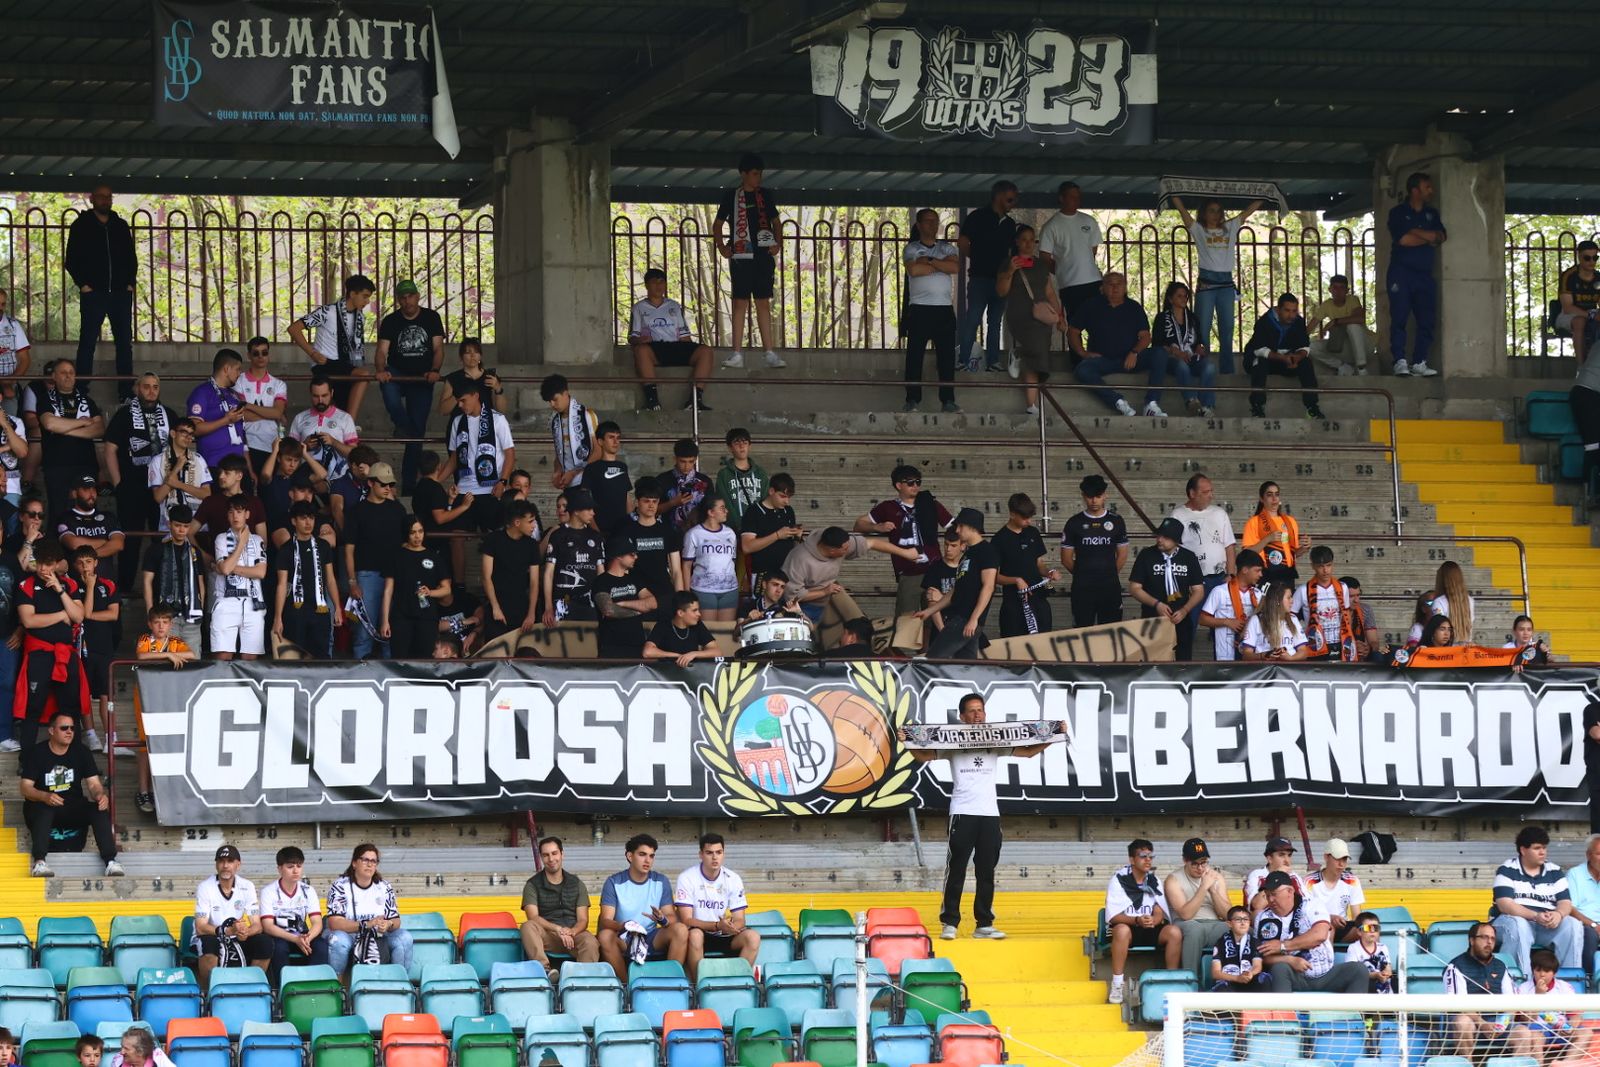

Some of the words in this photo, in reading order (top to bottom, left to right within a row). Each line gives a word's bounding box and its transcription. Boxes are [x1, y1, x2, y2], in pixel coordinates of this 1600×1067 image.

[1026, 28, 1129, 126] 23
[290, 64, 387, 106] FANS
[217, 110, 239, 120] QUOD
[242, 111, 276, 121] NATURA
[278, 111, 295, 121] NON
[925, 98, 1020, 131] ULTRAS
[76, 526, 107, 537] meins
[1082, 535, 1111, 546] meins
[1152, 562, 1188, 572] addas
[190, 684, 693, 791] GLORIOSA
[1132, 687, 1588, 788] BERNARDO
[937, 727, 1002, 743] VIAJEROS
[1004, 725, 1031, 741] UDS
[186, 828, 208, 840] 22
[256, 827, 278, 839] 20
[1395, 868, 1414, 880] 15
[1462, 868, 1479, 879] 17
[697, 899, 725, 910] meins
